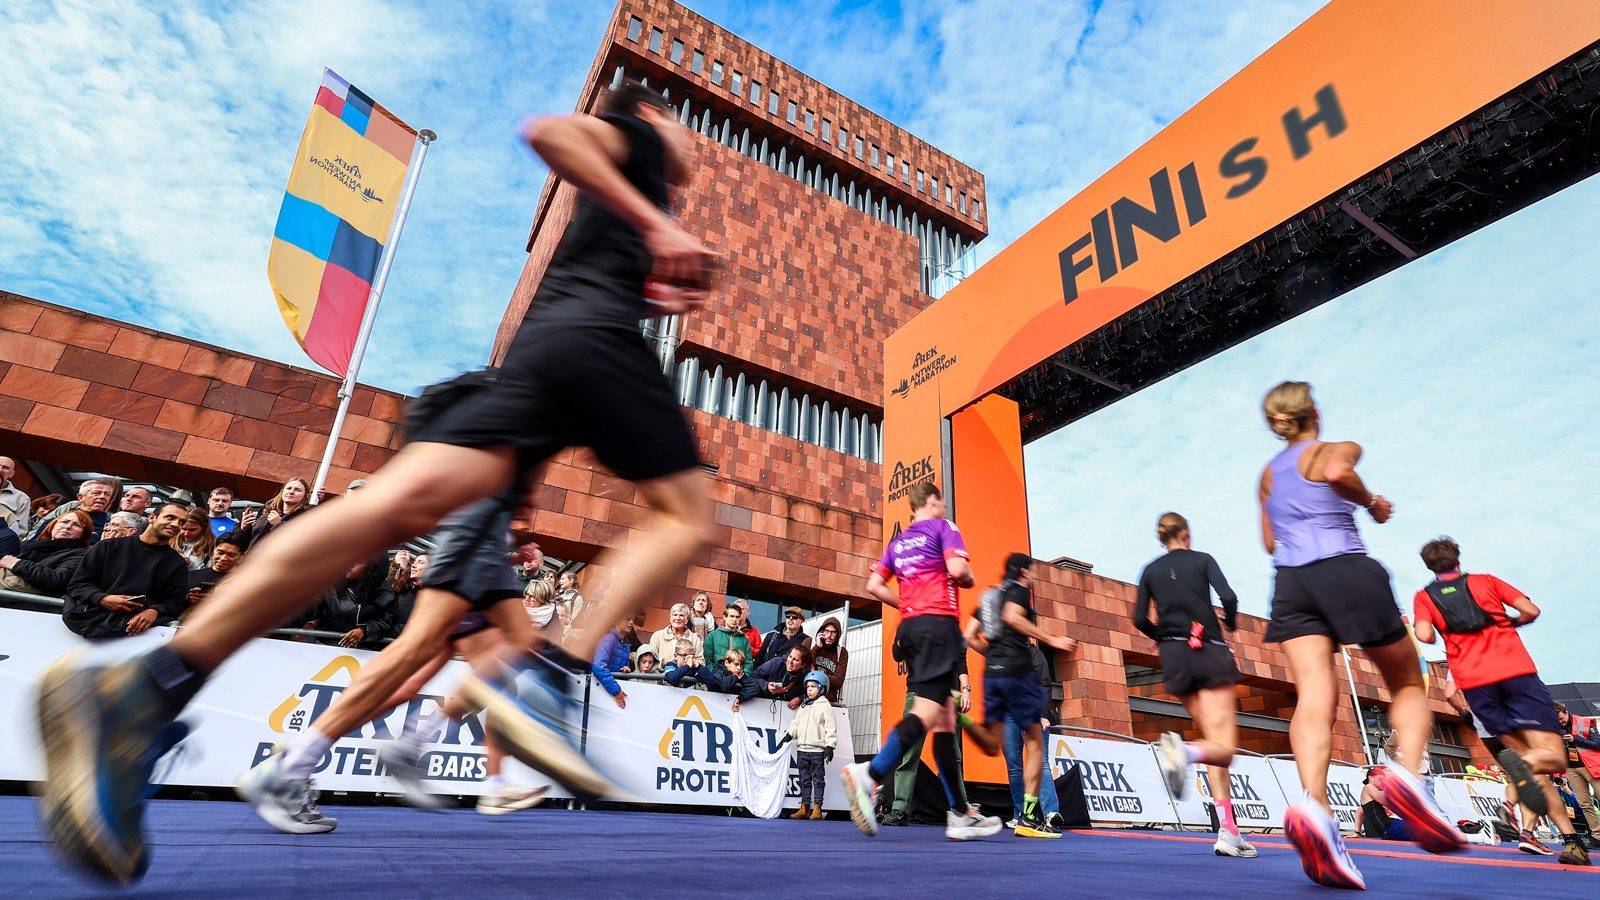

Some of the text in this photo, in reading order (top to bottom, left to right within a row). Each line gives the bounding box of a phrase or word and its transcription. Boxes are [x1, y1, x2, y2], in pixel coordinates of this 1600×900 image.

[1057, 83, 1348, 306] FINISH
[910, 354, 946, 383] ANTWERP
[913, 345, 938, 369] TREK
[913, 355, 957, 388] MARATHON
[889, 455, 934, 491] TREK
[288, 709, 306, 732] JB's
[672, 719, 798, 769] TR
[672, 741, 680, 758] JB's
[250, 742, 488, 779] POTEI BARS
[656, 767, 731, 794] PROTE
[1055, 758, 1134, 793] TREK
[1197, 771, 1261, 801] TEK
[1084, 795, 1140, 813] TEIN BARS
[1326, 782, 1360, 807] REK
